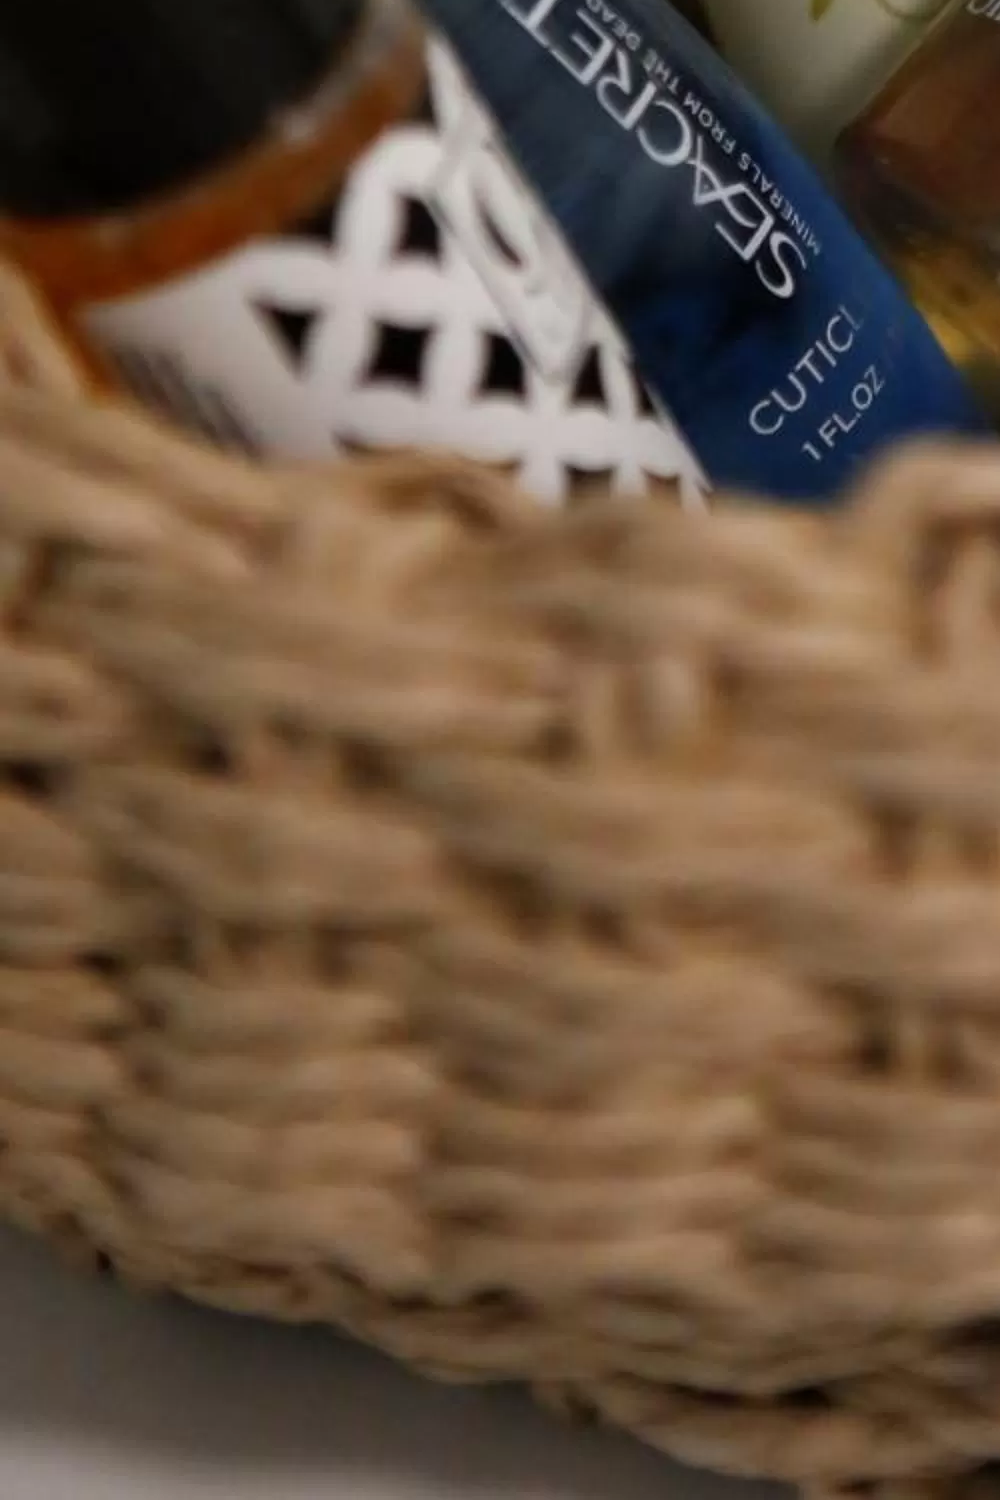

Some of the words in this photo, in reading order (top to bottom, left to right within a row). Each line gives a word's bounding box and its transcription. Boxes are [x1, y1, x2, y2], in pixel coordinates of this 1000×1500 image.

[642, 49, 685, 97] THE
[682, 93, 736, 150] FROM
[737, 152, 822, 257] MINERALS
[748, 304, 863, 436] CUTICL
[801, 442, 823, 462] 1
